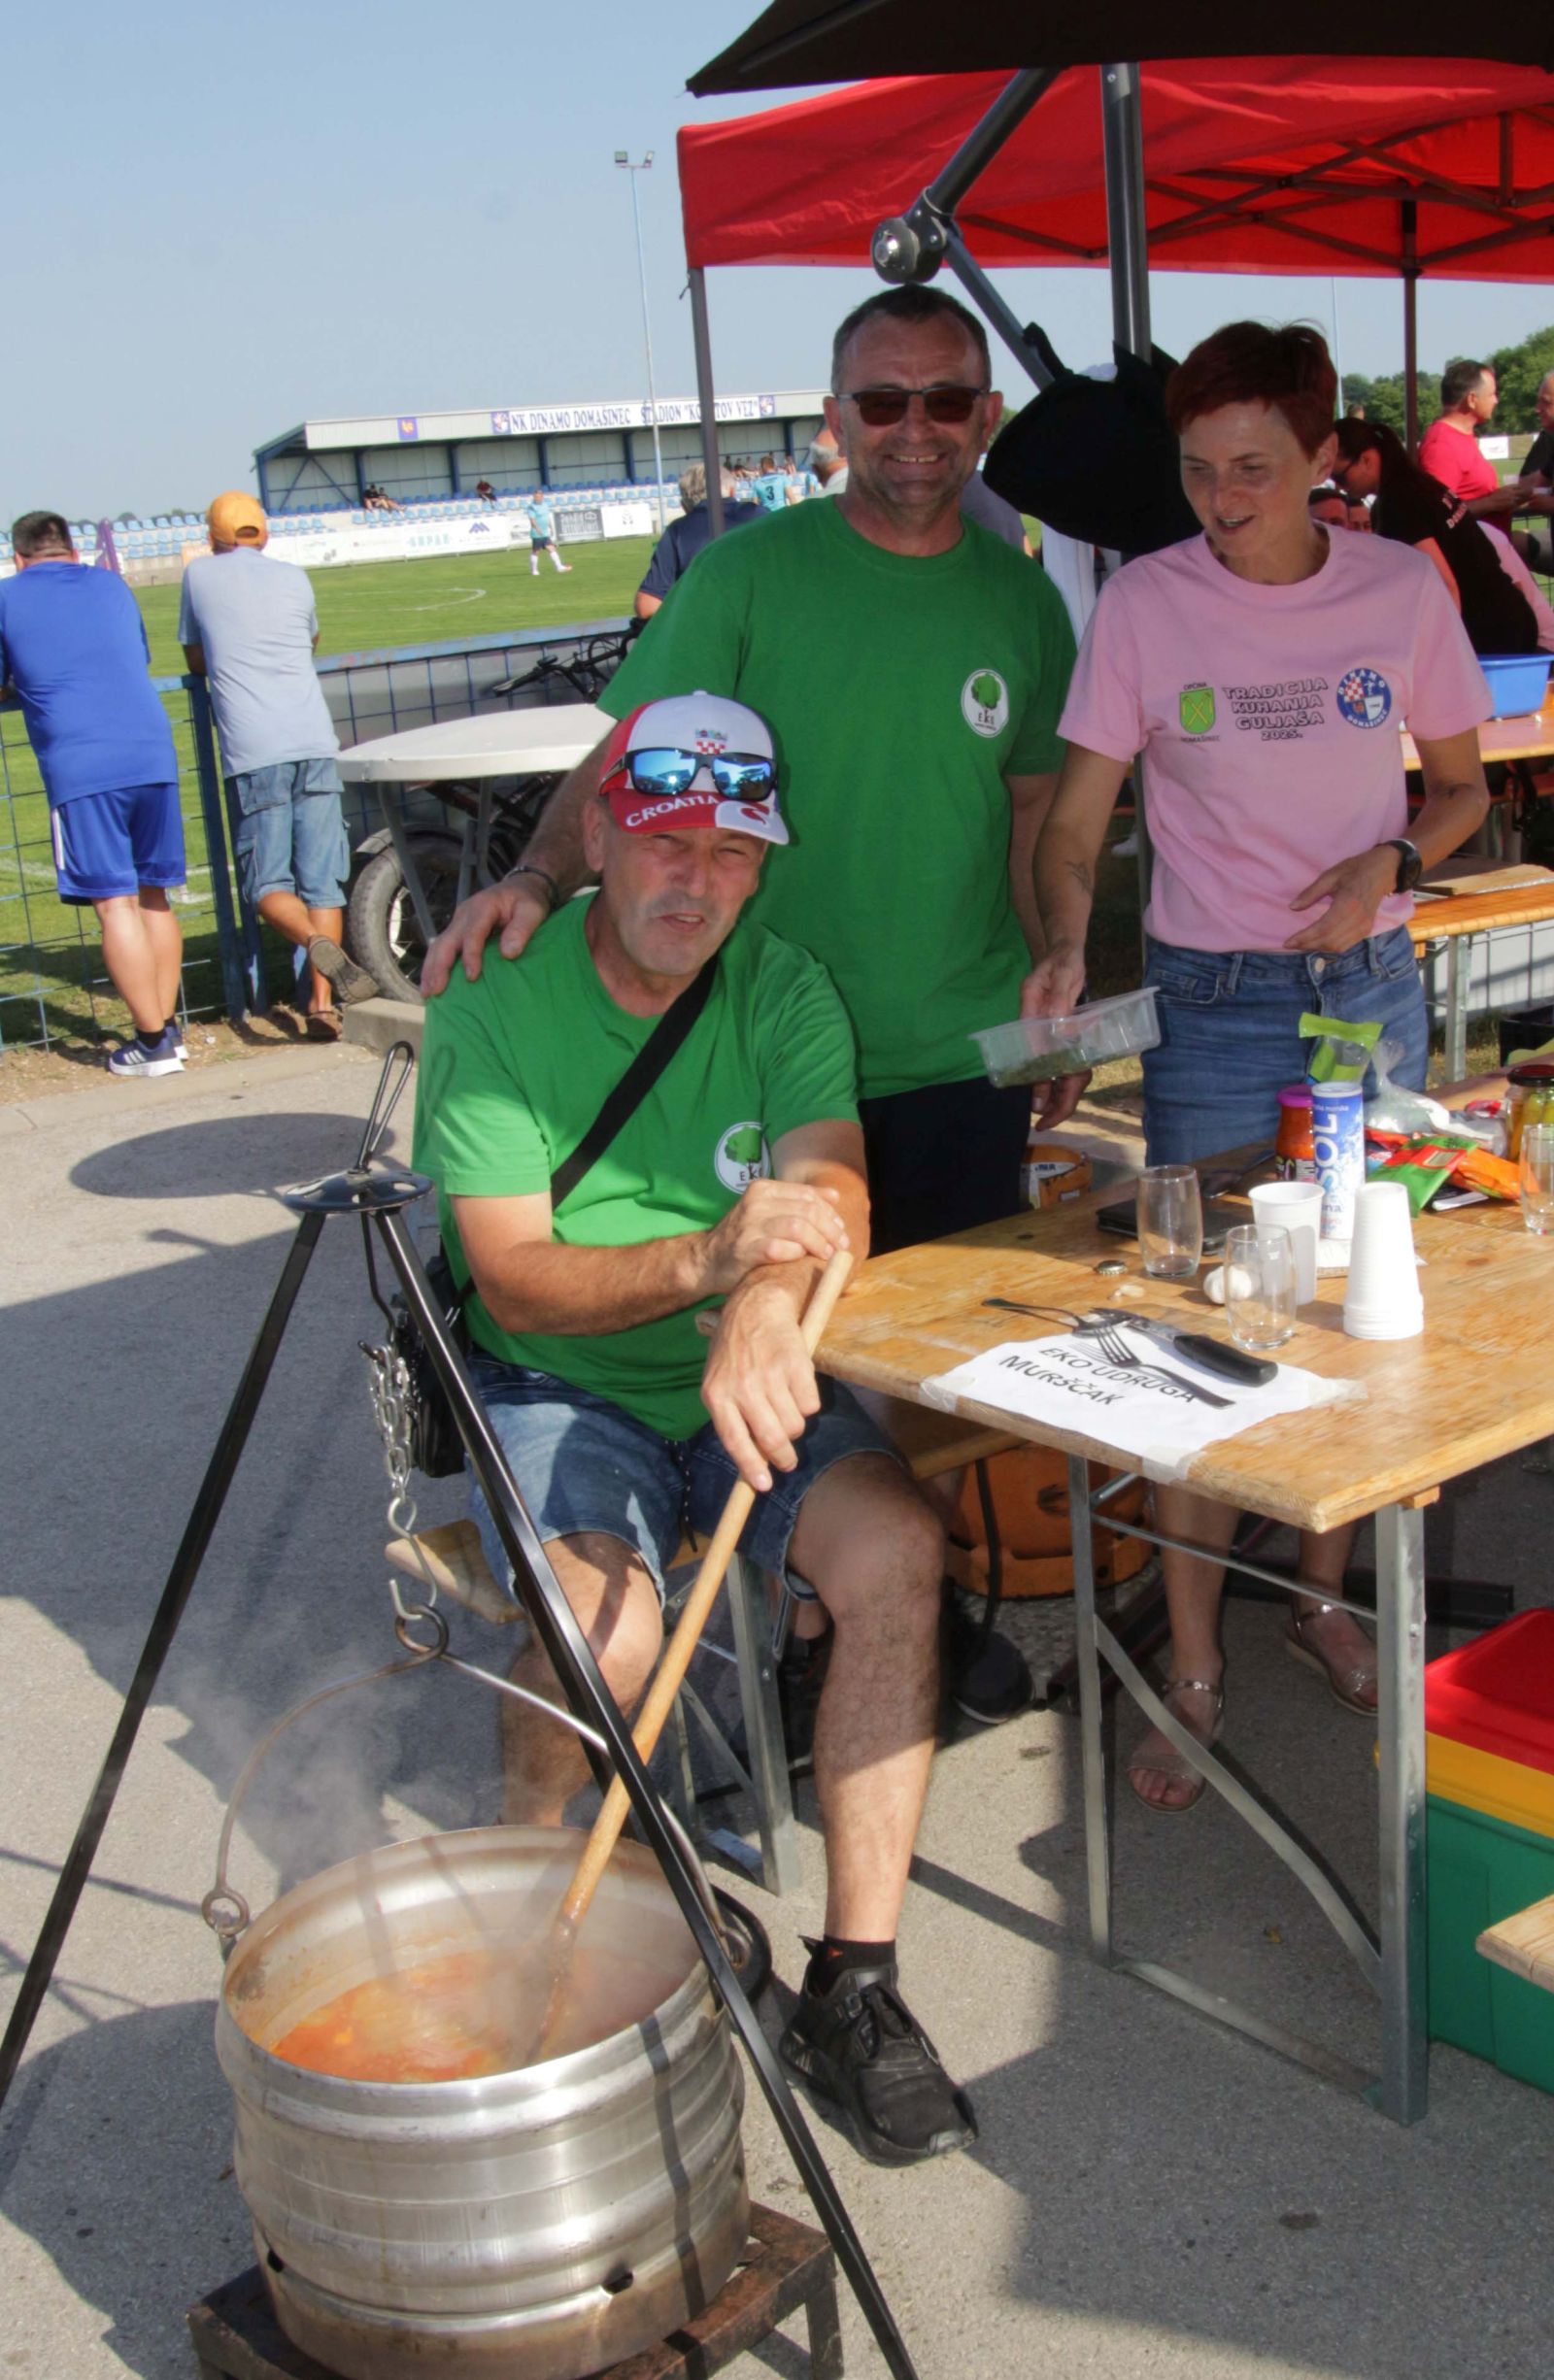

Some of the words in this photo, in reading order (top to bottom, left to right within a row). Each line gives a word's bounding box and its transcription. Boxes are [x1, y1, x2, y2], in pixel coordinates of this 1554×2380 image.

[512, 414, 527, 431] NK
[529, 412, 571, 430] DINAMO
[765, 486, 775, 501] 3
[1222, 677, 1329, 700] TRADICIJA
[1232, 694, 1324, 714] KUHANJA
[1235, 711, 1325, 730] GULJAŠA
[1261, 729, 1303, 741] 2025.
[625, 794, 721, 827] CROATIA
[998, 1355, 1126, 1405] MURŠČAK
[1039, 1347, 1093, 1369] EKO
[1091, 1365, 1198, 1403] UDRUGA
